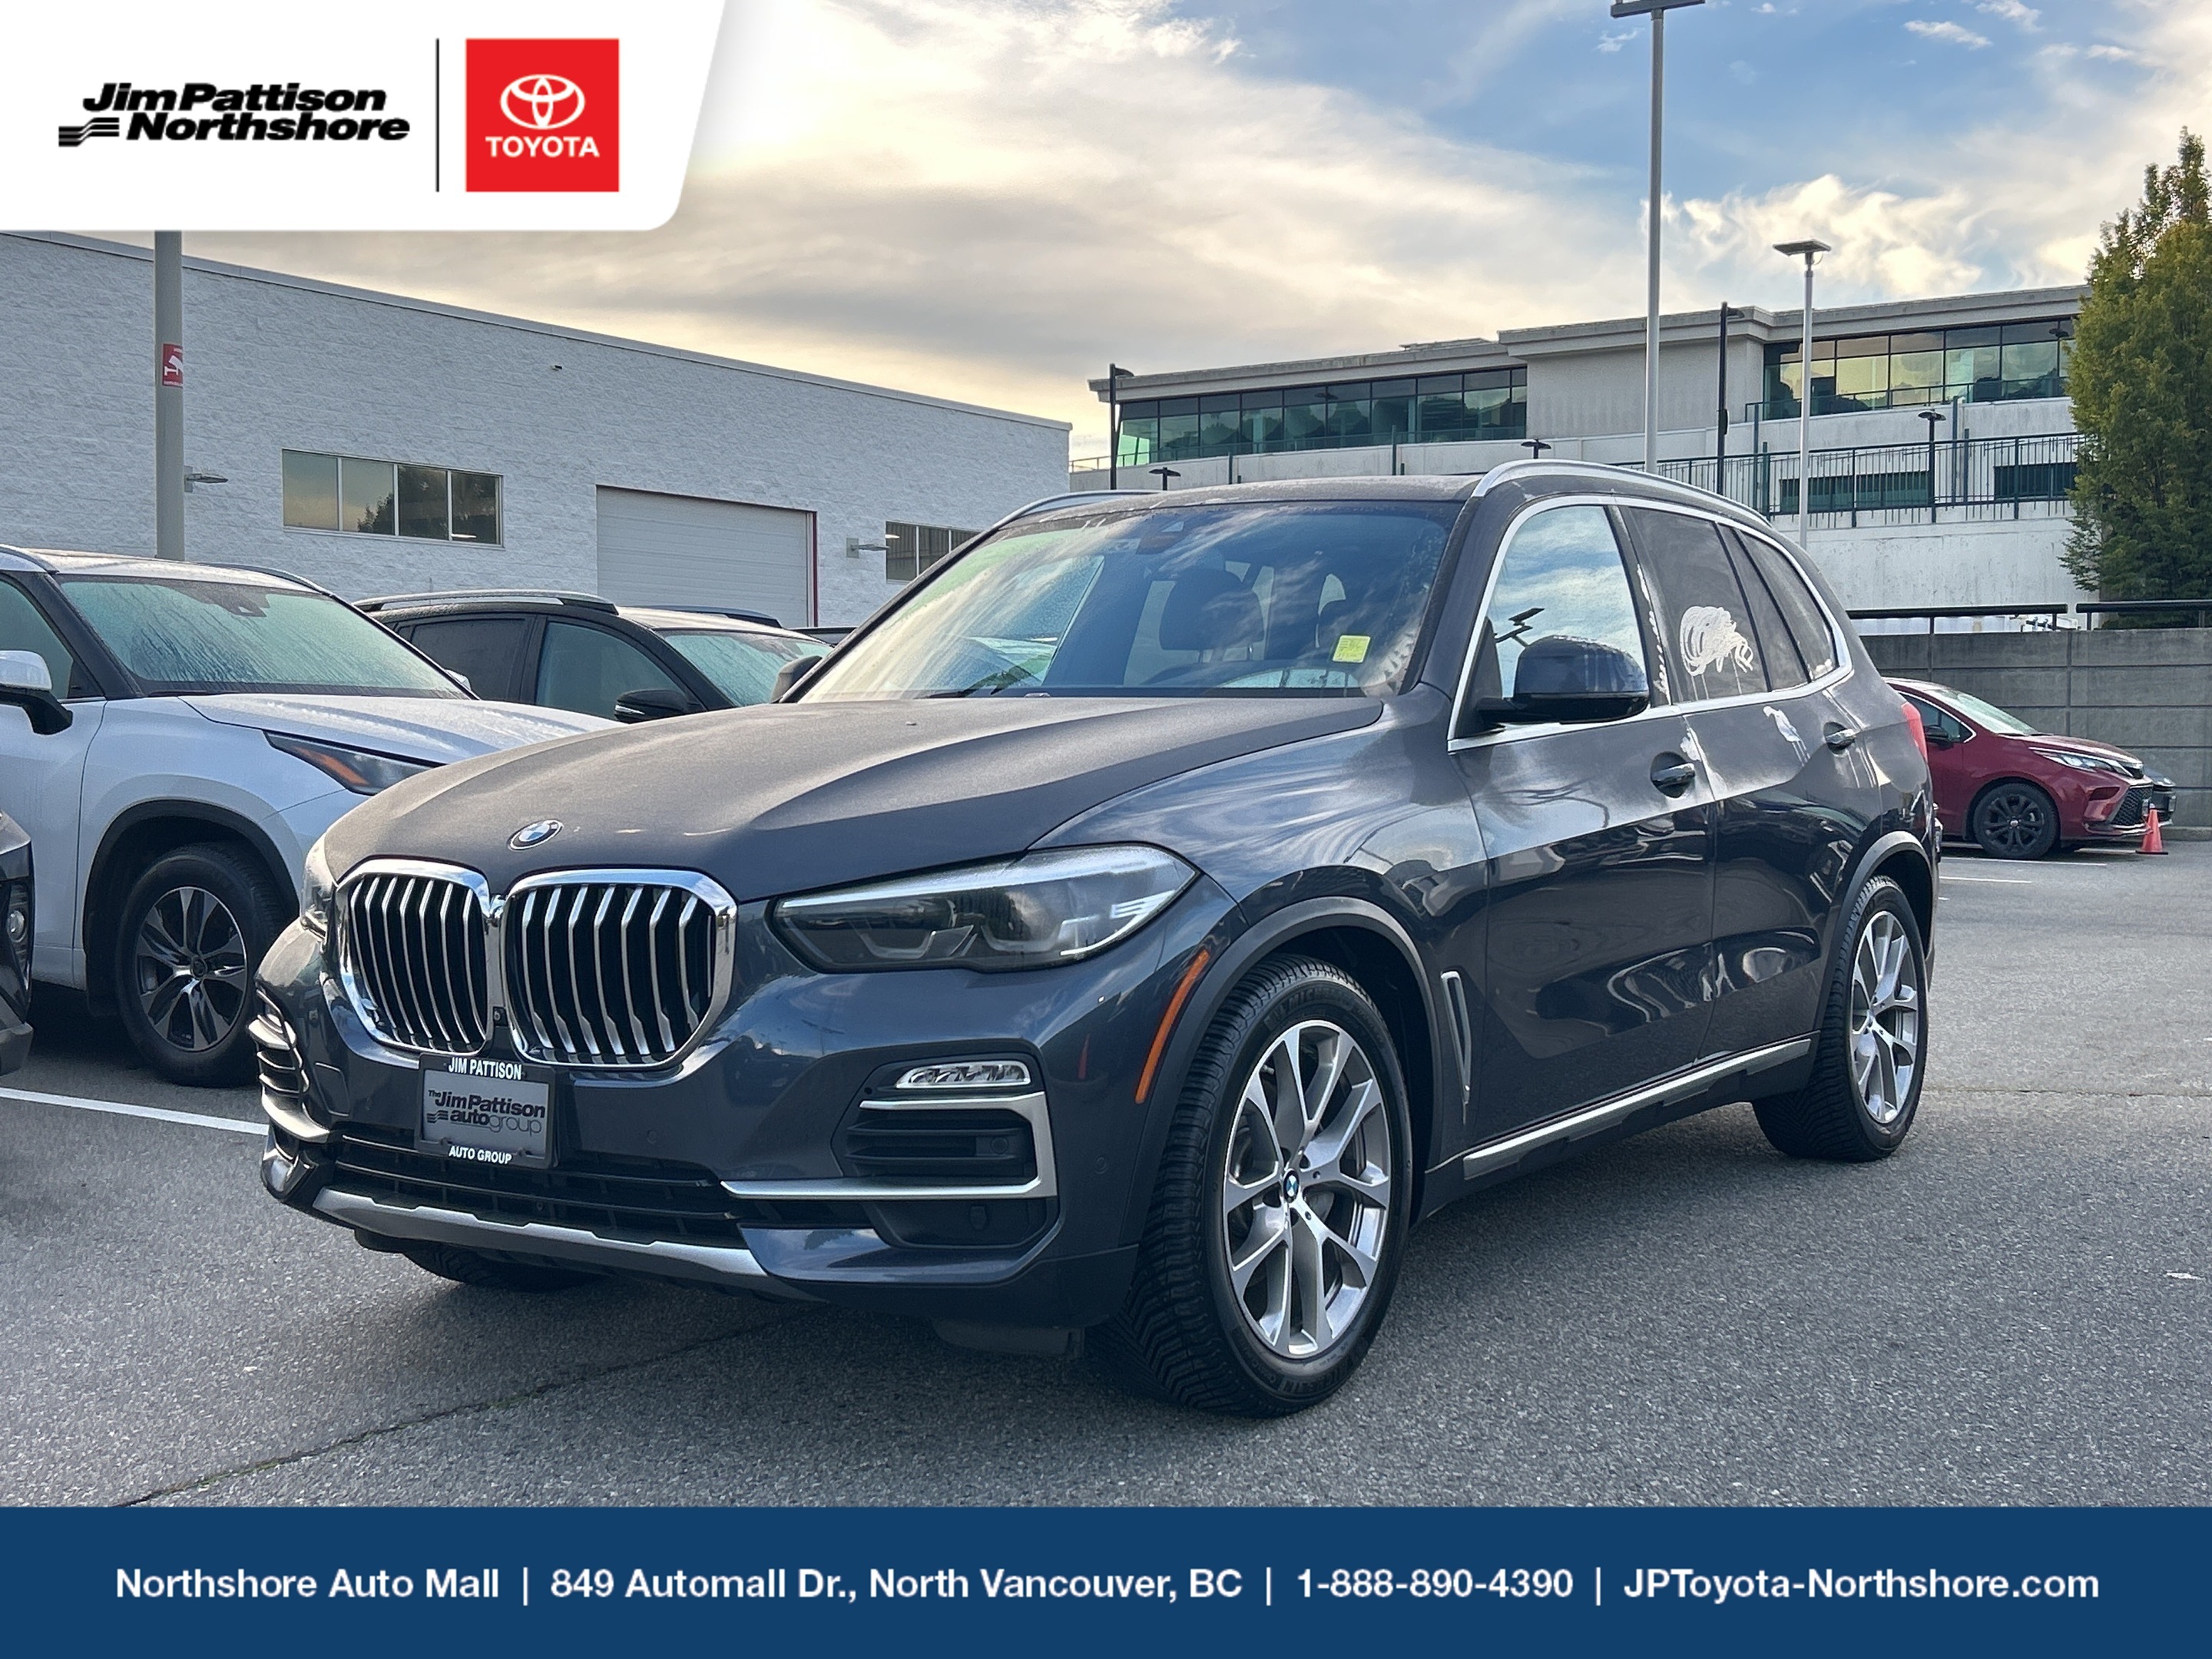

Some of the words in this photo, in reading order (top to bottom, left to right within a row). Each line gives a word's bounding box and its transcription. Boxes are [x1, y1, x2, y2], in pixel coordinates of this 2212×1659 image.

[449, 1057, 467, 1075] JIM
[469, 1059, 522, 1081] PATTISON
[429, 1089, 442, 1098] The
[435, 1091, 467, 1109] Jim
[468, 1094, 546, 1118] Pattison
[449, 1145, 475, 1160] AUTO
[477, 1149, 512, 1164] GROUP
